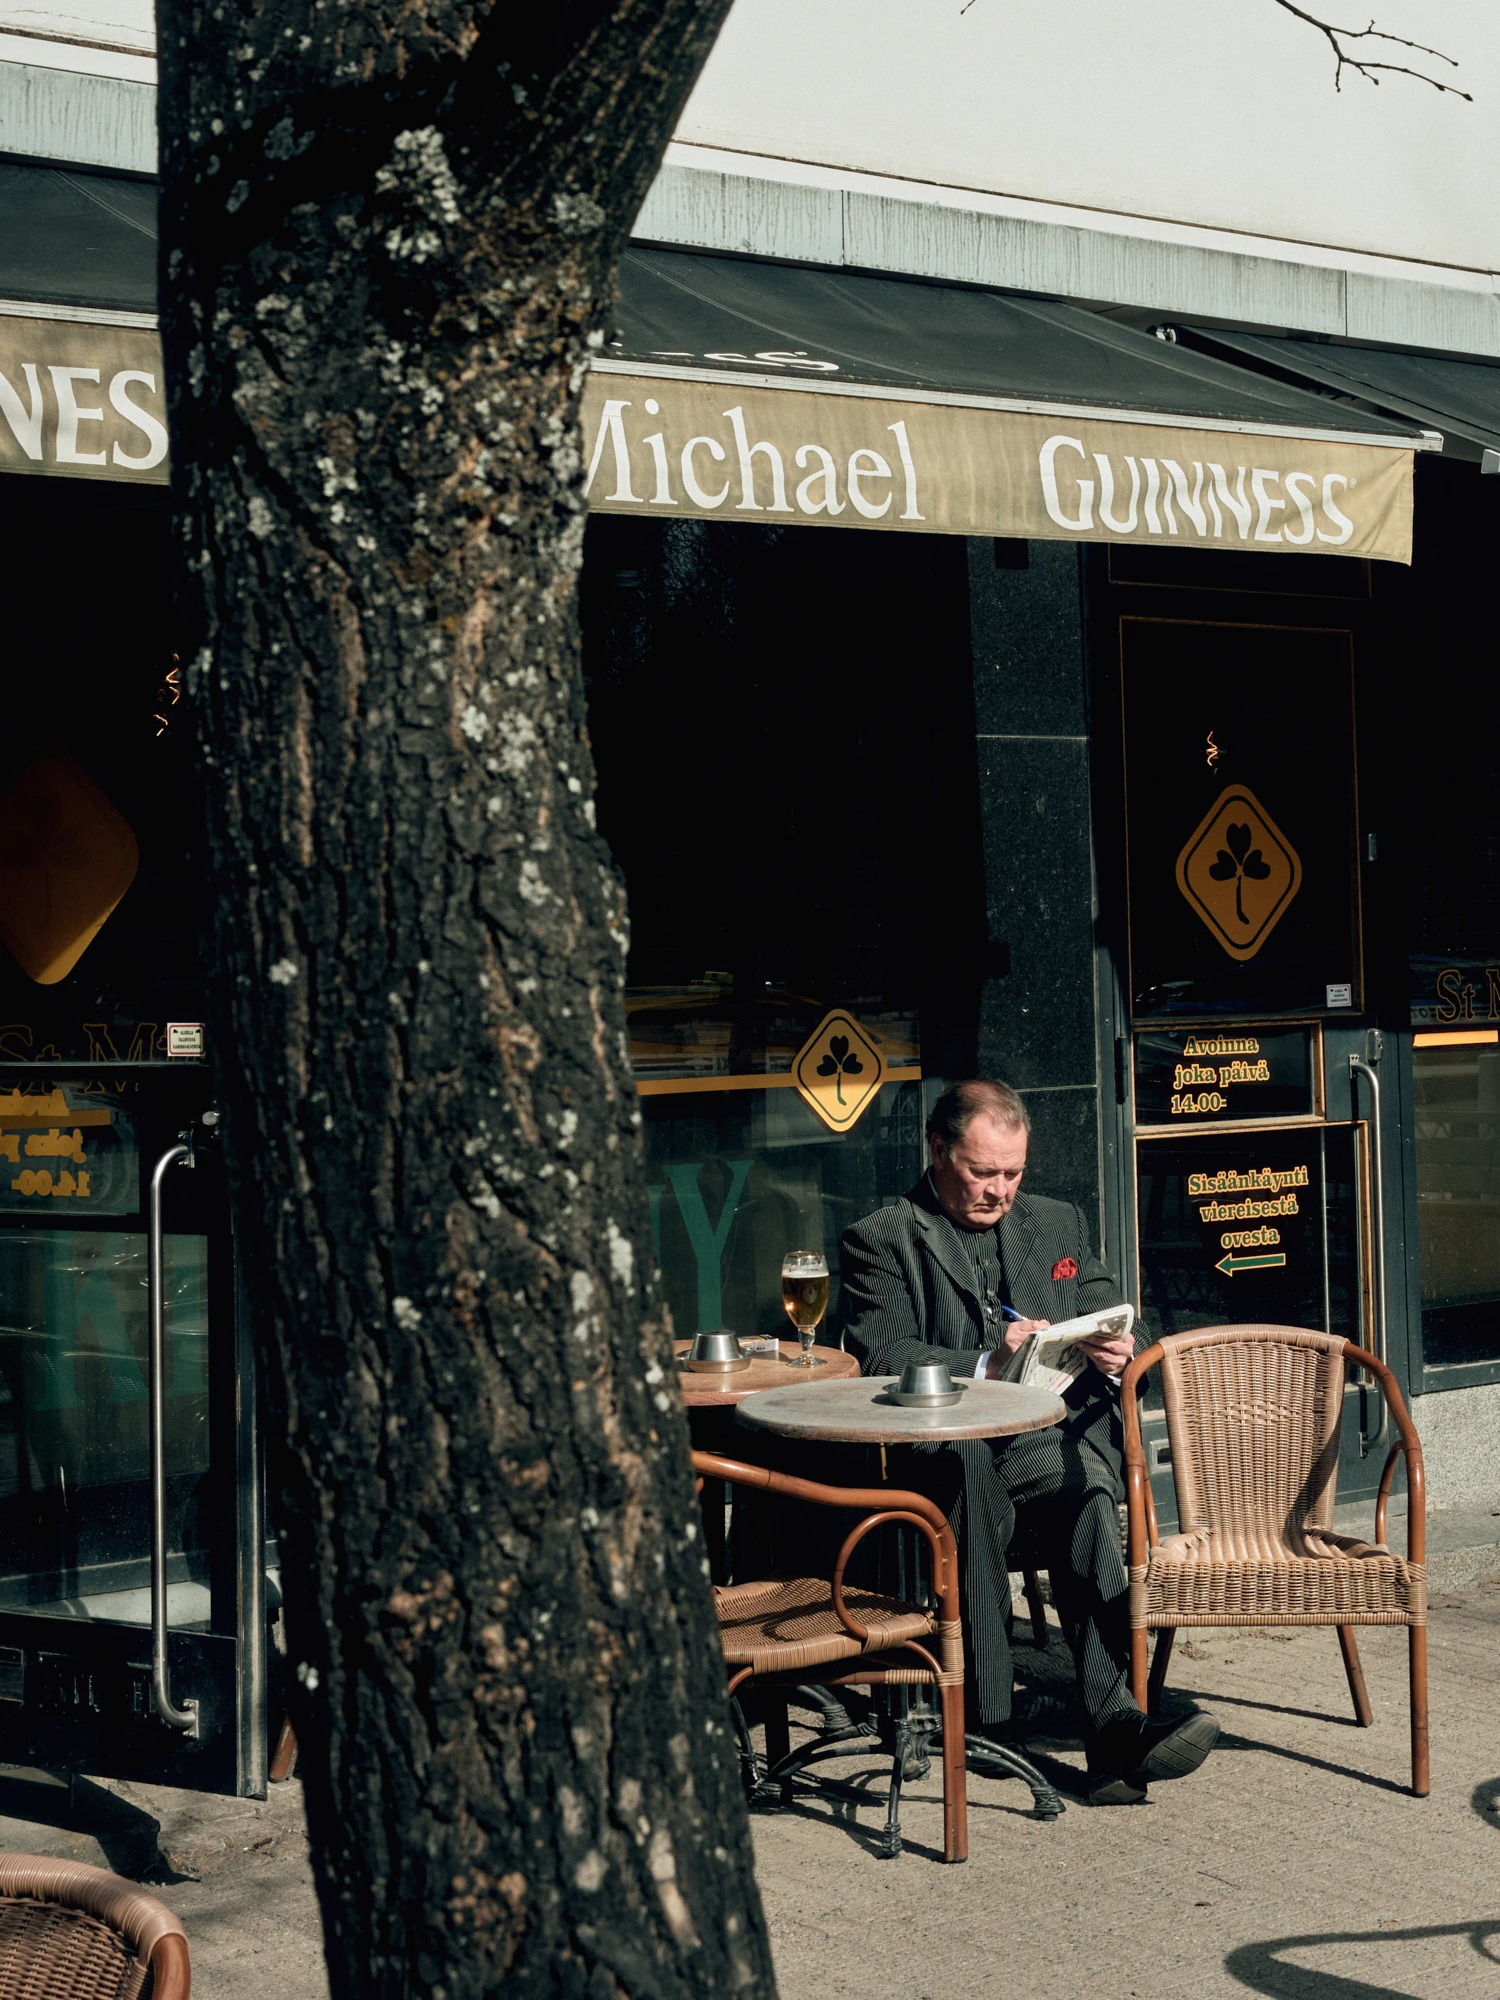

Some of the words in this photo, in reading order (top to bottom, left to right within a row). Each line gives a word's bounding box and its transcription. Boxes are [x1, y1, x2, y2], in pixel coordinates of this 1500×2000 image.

[1184, 1034, 1259, 1057] Avoinna
[1173, 1063, 1217, 1089] joka
[1219, 1059, 1270, 1088] päivä
[1188, 1166, 1309, 1196] Sisäänkäynti
[1199, 1194, 1299, 1222] viereisestä
[1221, 1226, 1280, 1249] ovesta
